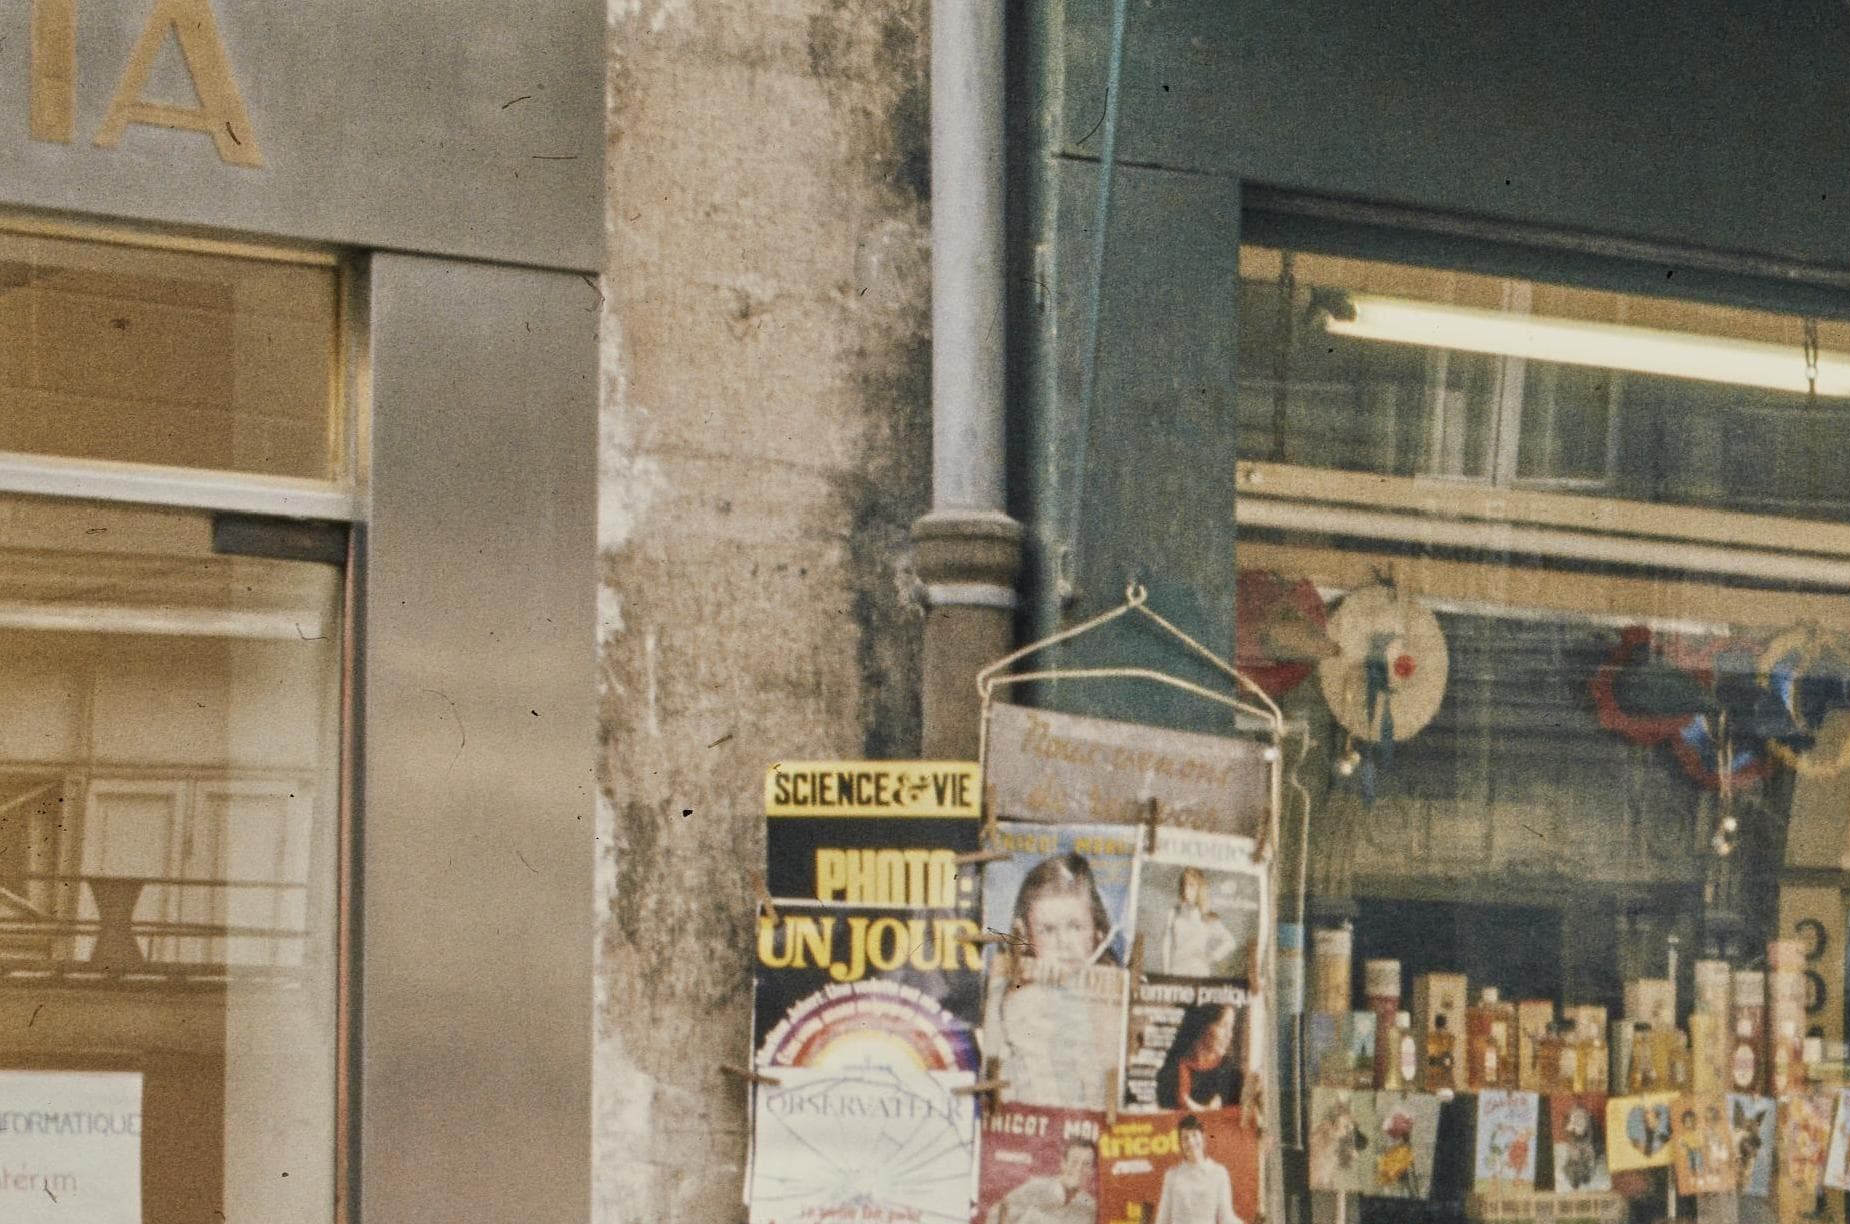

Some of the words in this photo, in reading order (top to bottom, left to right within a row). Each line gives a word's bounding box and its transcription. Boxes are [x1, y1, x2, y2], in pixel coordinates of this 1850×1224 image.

[774, 770, 893, 807] SCIENCE
[933, 772, 974, 809] VIE
[757, 917, 841, 968] UN
[832, 916, 984, 982] JOUR
